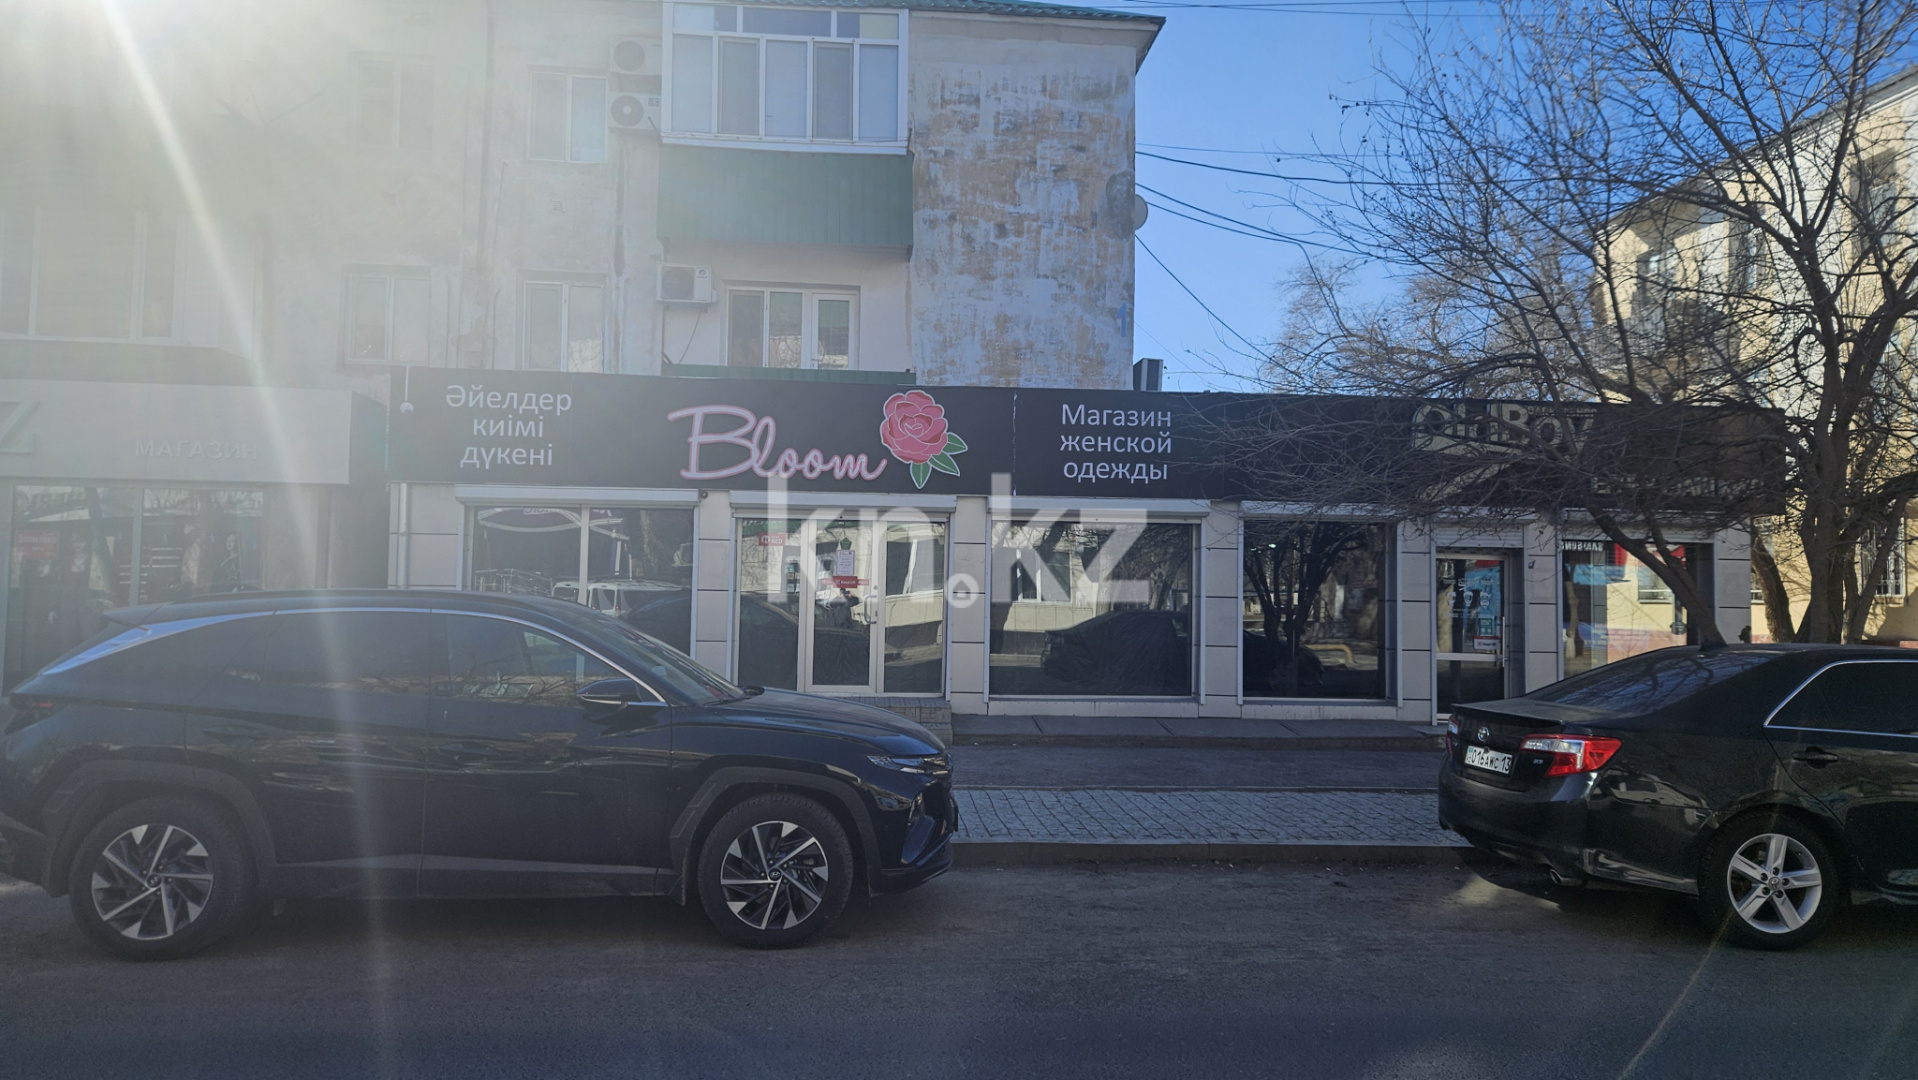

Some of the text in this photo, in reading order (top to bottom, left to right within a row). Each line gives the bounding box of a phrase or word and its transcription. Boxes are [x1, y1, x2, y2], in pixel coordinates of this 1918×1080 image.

[446, 384, 572, 416] Әйелдер
[473, 415, 544, 437] киімі
[1061, 404, 1171, 427] Магазин
[134, 438, 258, 460] МАГАЗИН
[667, 404, 888, 481] Bloom
[1060, 431, 1172, 453] женской
[460, 443, 553, 469] дүкені
[1063, 462, 1168, 484] одежды
